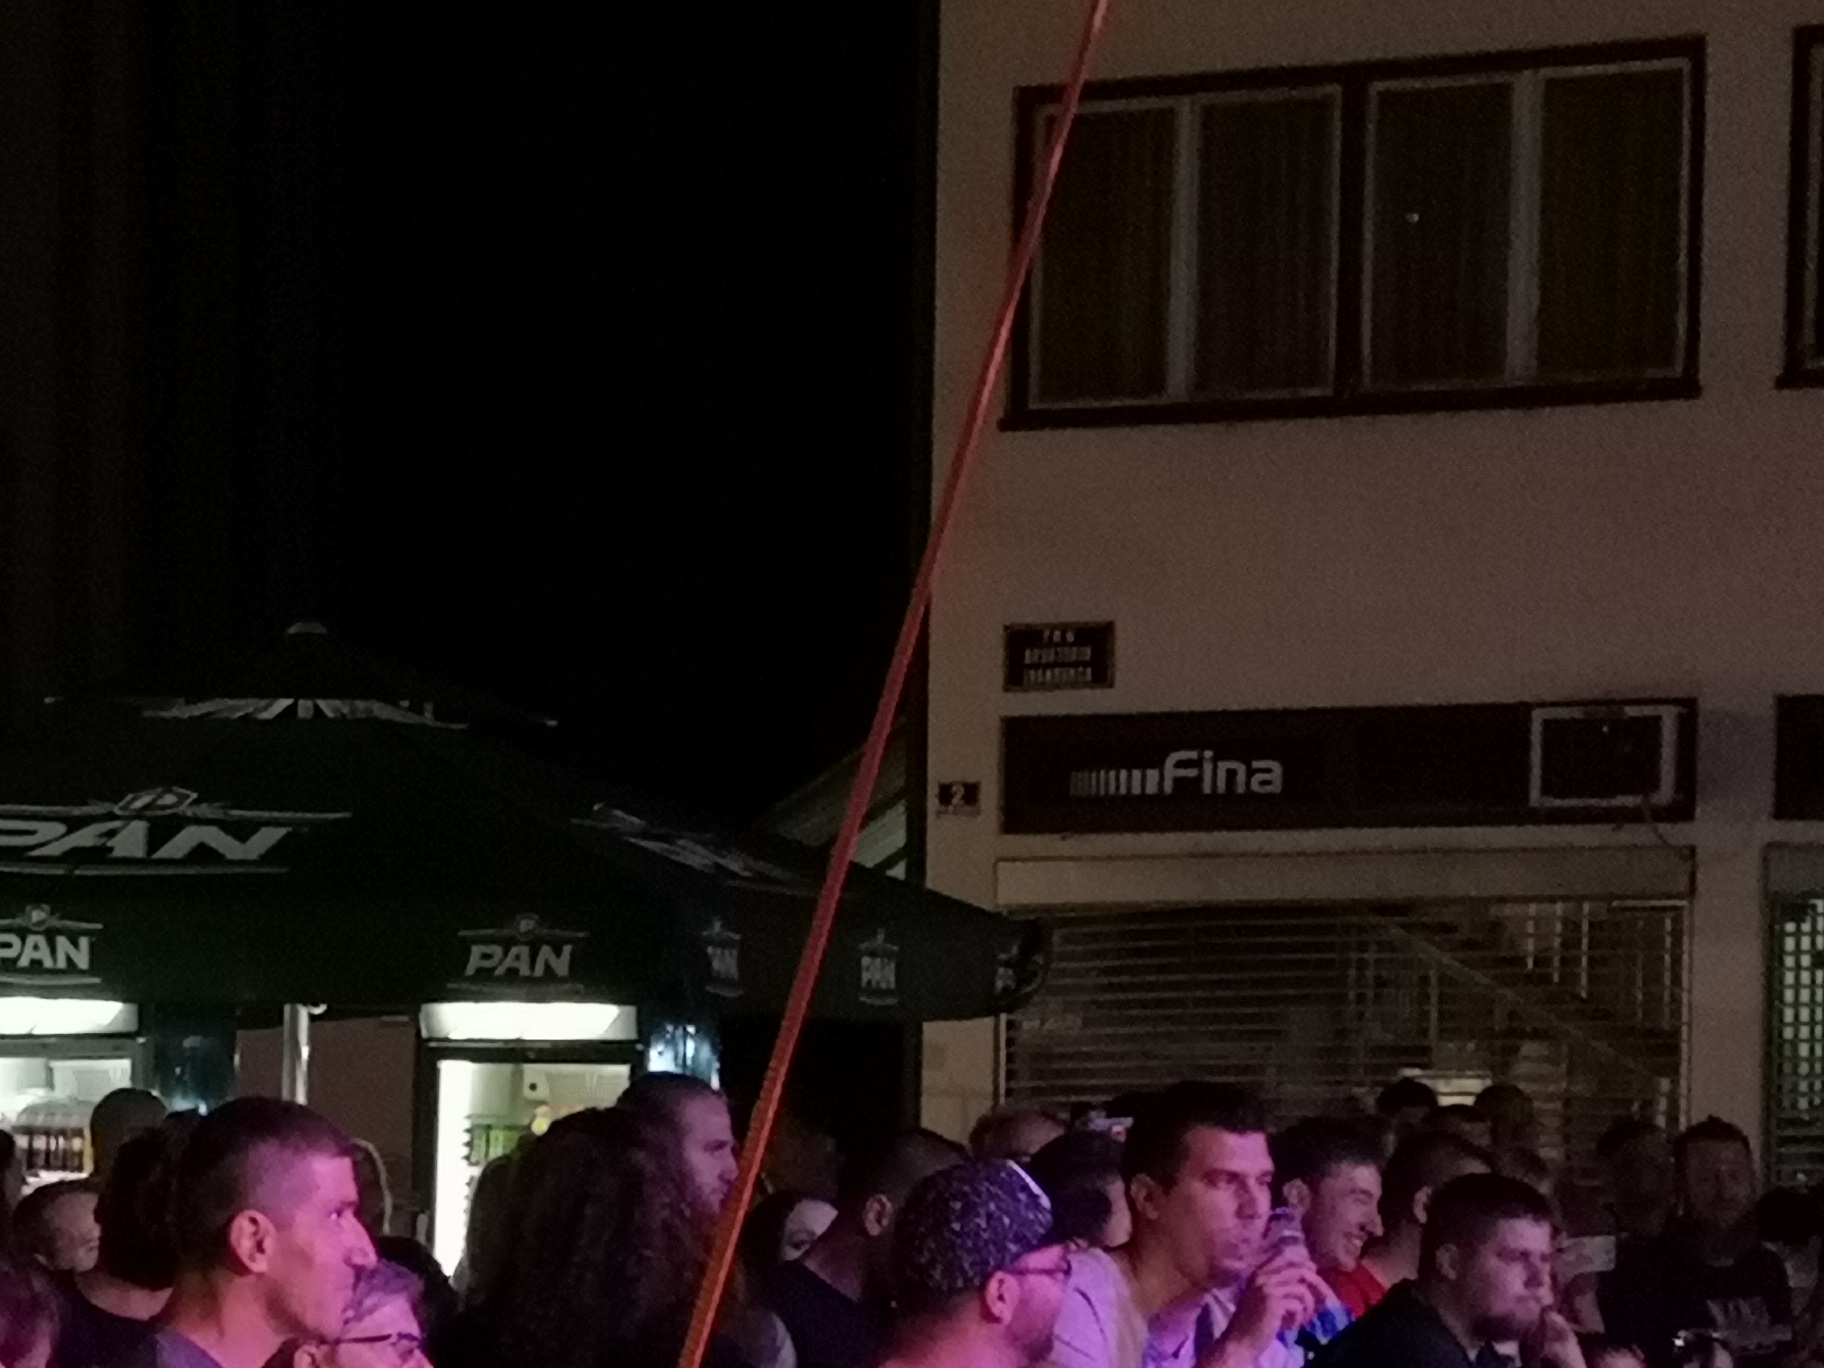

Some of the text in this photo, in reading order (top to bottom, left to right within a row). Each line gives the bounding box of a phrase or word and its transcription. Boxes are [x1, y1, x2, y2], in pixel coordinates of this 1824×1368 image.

[1162, 749, 1285, 796] Fina
[951, 783, 965, 806] 2
[464, 945, 572, 977] PAN
